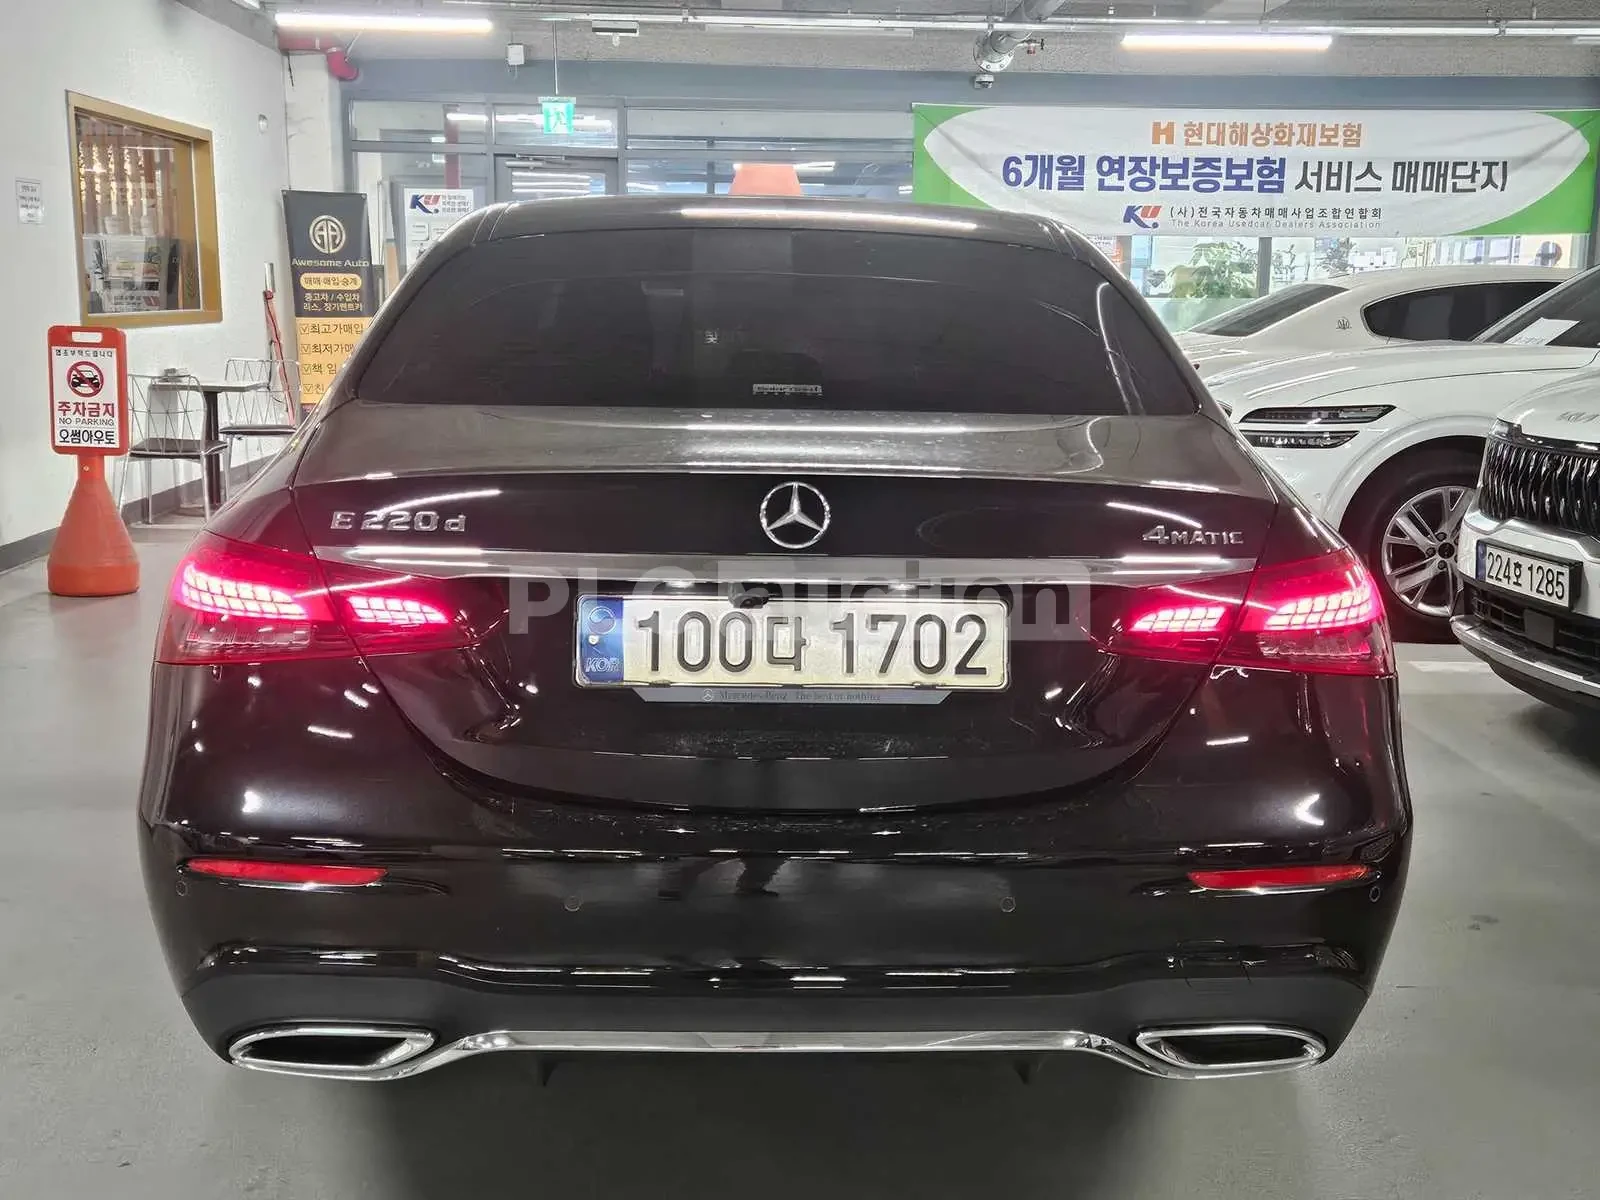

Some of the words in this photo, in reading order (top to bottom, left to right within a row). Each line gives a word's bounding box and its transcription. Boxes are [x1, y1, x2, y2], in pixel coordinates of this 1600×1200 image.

[1183, 121, 1363, 148] 현대해상화재보험
[1002, 155, 1085, 191] 6개월
[1096, 155, 1286, 193] 연장보증보험
[1295, 160, 1383, 193] 서비스
[1391, 160, 1508, 193] 매매단지
[1169, 206, 1382, 220] (사)전국자동차매매사업조합연합회
[1171, 219, 1191, 228] The
[1194, 219, 1225, 229] Korea
[1229, 220, 1270, 229] Usedcar
[1274, 220, 1314, 229] Dealers
[1318, 220, 1381, 229] Association
[291, 258, 343, 267] Awesome
[344, 259, 370, 267] Auto
[304, 292, 329, 302] 중고차
[336, 292, 360, 302] 수입차
[310, 323, 364, 335] 최고가매입
[57, 401, 115, 418] 주차금지
[58, 417, 72, 425] NO
[75, 418, 115, 426] PARKING
[59, 428, 116, 445] 오썸아우토
[330, 511, 356, 530] E
[1142, 525, 1244, 545] 4MATIC
[1487, 551, 1523, 588] 224호
[1527, 563, 1565, 600] 1285
[637, 610, 807, 674] 100다
[830, 612, 988, 676] 1702
[584, 657, 619, 672] KOR
